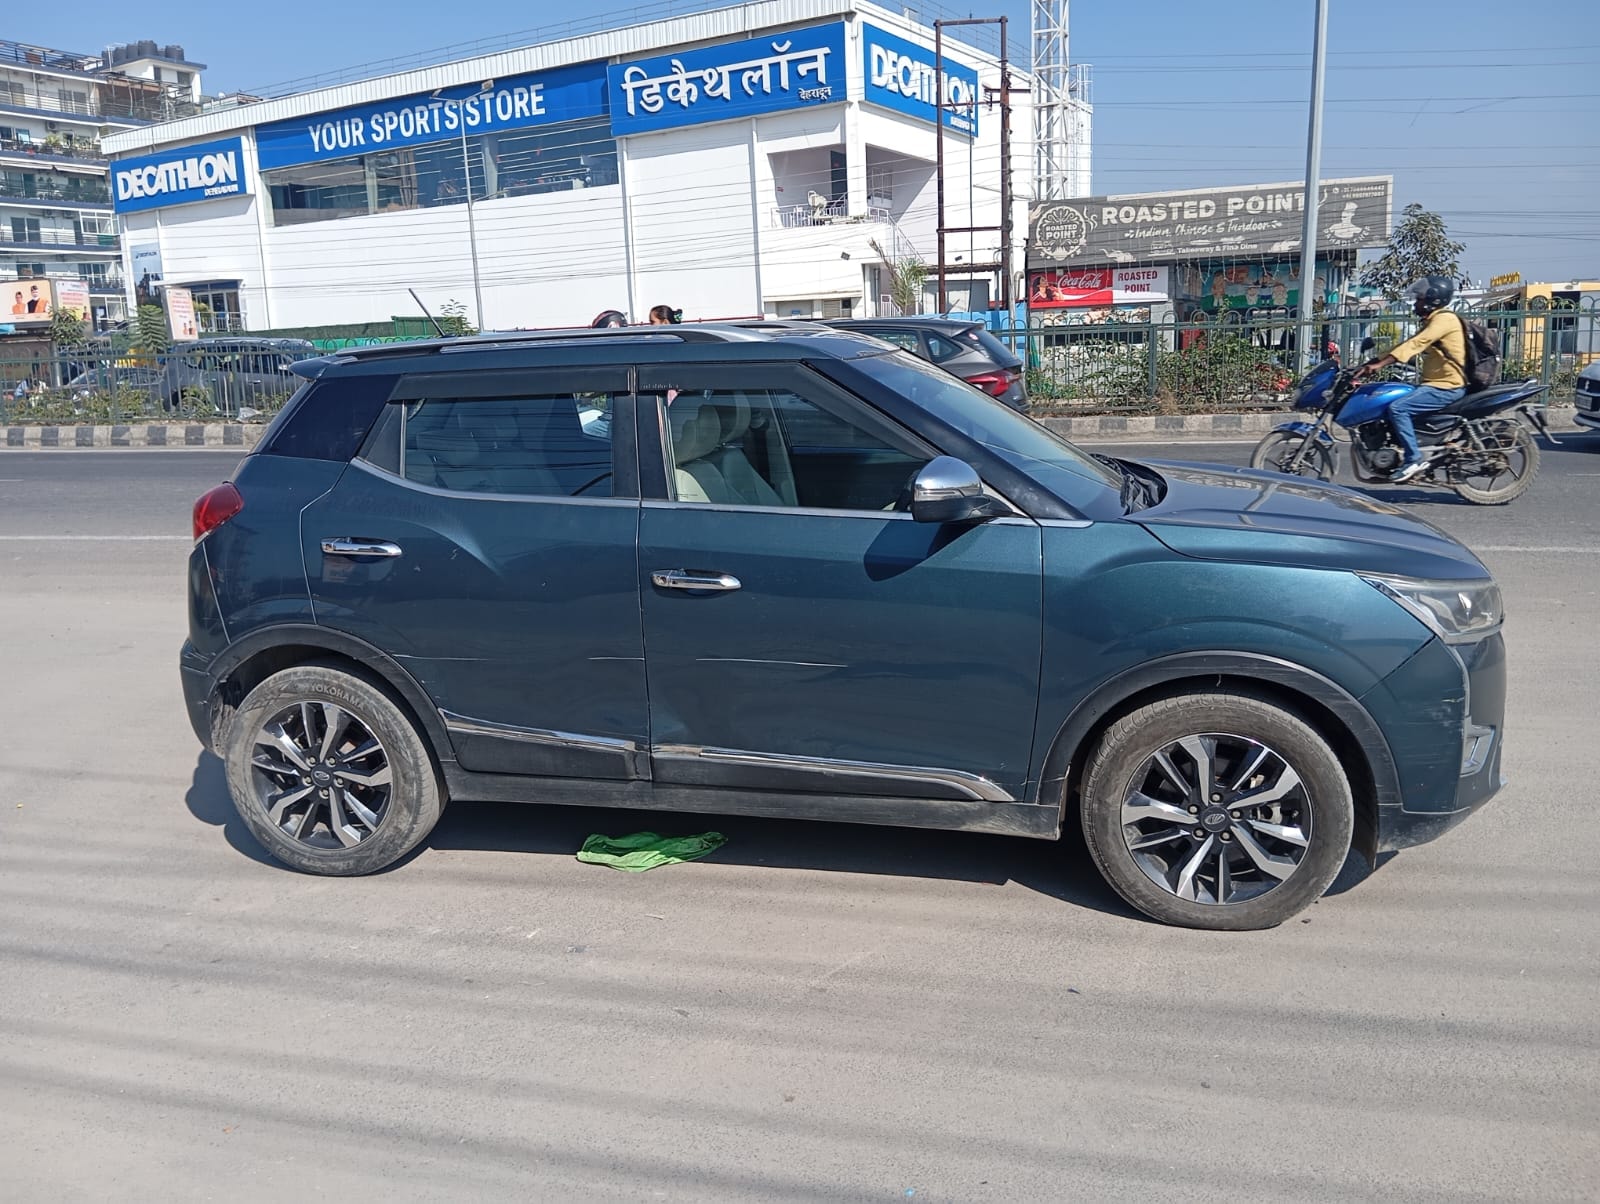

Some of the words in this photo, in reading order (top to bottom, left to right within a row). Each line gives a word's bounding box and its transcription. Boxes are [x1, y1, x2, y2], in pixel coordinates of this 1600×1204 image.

[621, 40, 832, 116] डिकैथलॉन
[798, 86, 832, 100] देहरादून
[308, 118, 365, 153] YOUR
[370, 101, 459, 143] SPORTS
[465, 83, 546, 126] STORE
[116, 151, 238, 201] DECATHLON
[1102, 200, 1217, 225] ROASTED
[1227, 192, 1304, 217] POINT
[1046, 223, 1078, 232] ROASTED
[1046, 231, 1077, 240] POINT
[1118, 271, 1158, 281] ROASTED
[1124, 283, 1151, 293] POINT
